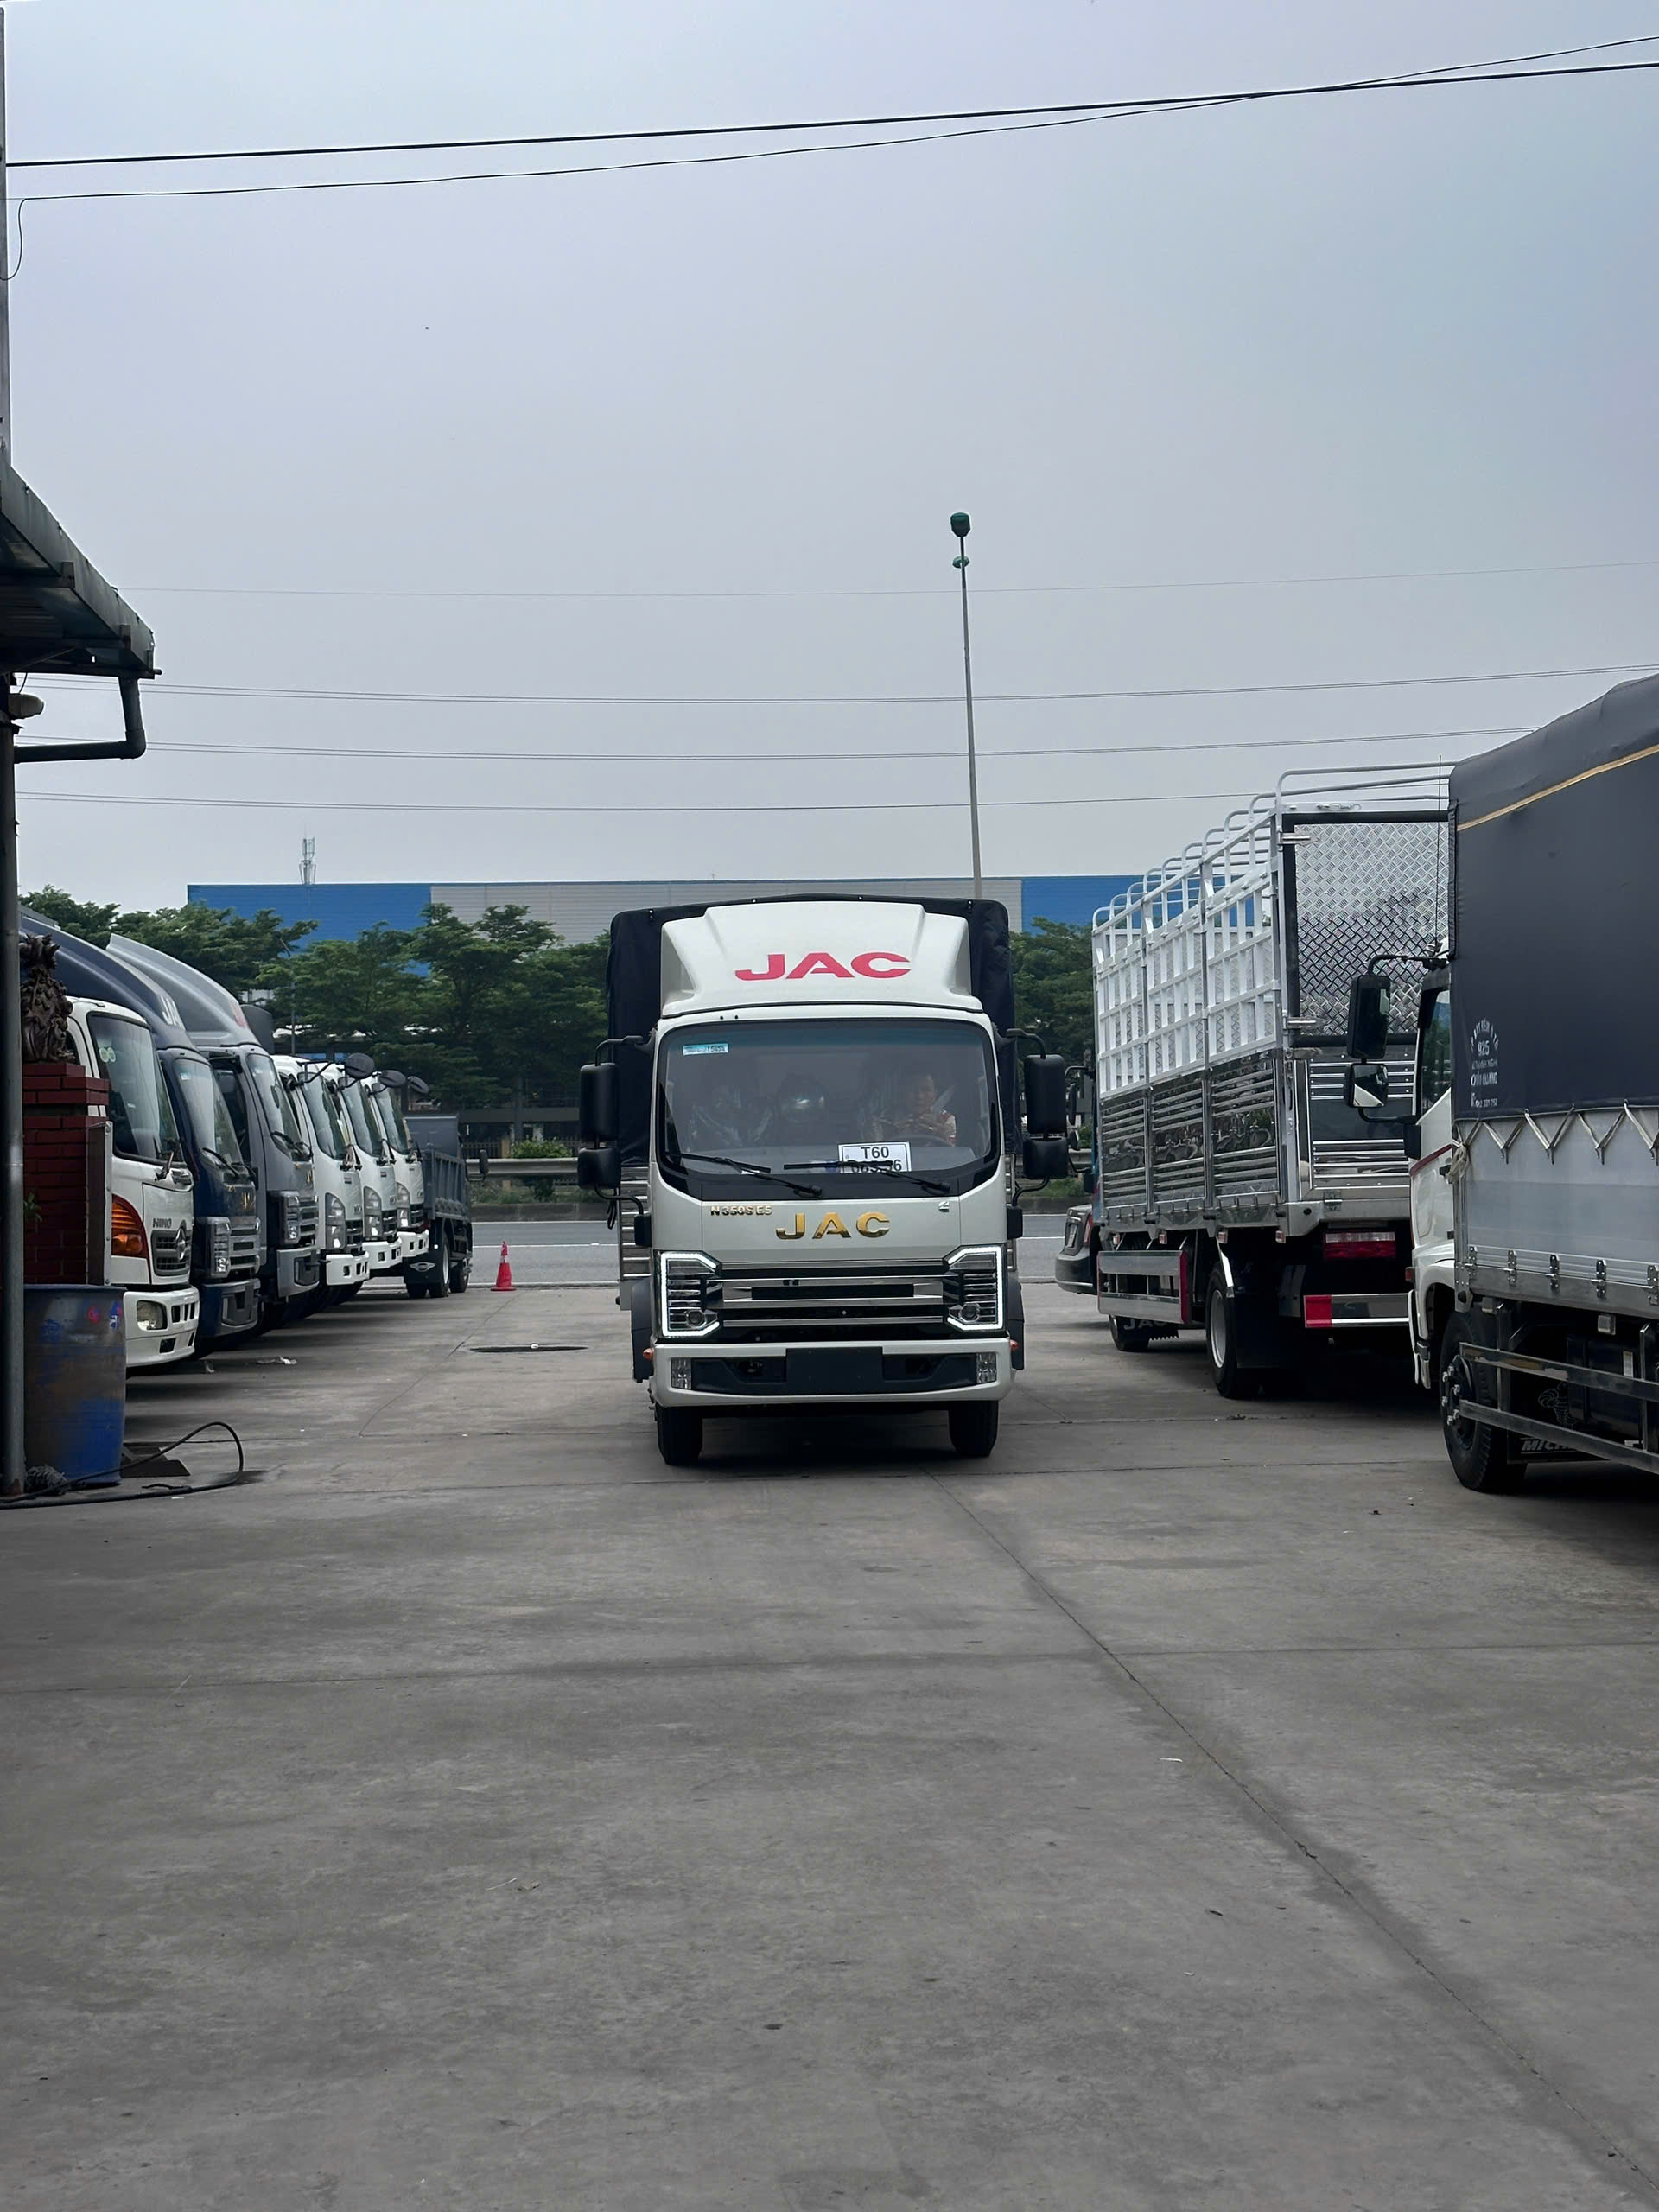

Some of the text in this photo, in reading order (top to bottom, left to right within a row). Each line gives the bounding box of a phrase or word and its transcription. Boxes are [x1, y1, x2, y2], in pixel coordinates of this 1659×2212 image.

[735, 952, 912, 981] JAC
[160, 995, 186, 1031] JA
[1478, 1039, 1490, 1056] 925
[861, 1147, 889, 1159] T60
[756, 1205, 772, 1216] E5
[153, 1217, 172, 1229] HINO
[776, 1211, 890, 1239] JAC
